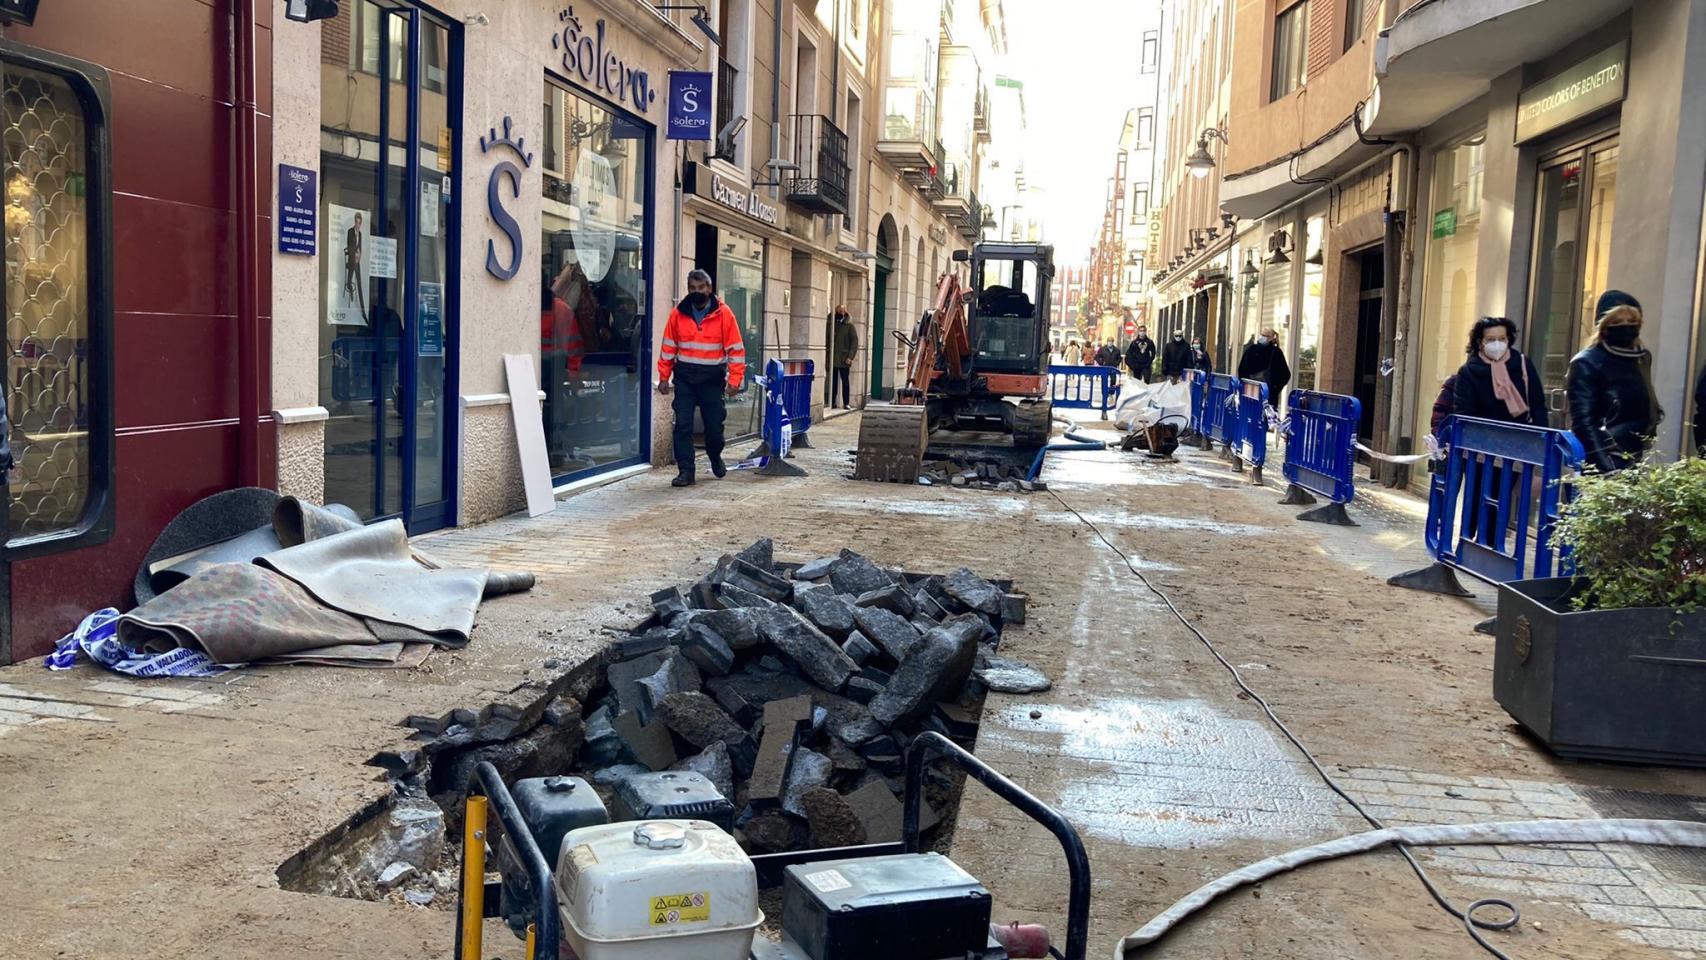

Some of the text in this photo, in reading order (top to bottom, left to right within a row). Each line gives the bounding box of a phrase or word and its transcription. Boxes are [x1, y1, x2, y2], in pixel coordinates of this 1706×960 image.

[562, 18, 648, 113] solera
[1518, 60, 1625, 124] UNITED COLORS OF BENETTON
[674, 115, 705, 126] solera
[711, 174, 777, 224] Carmen Alonso
[1149, 211, 1161, 265] HOTEL
